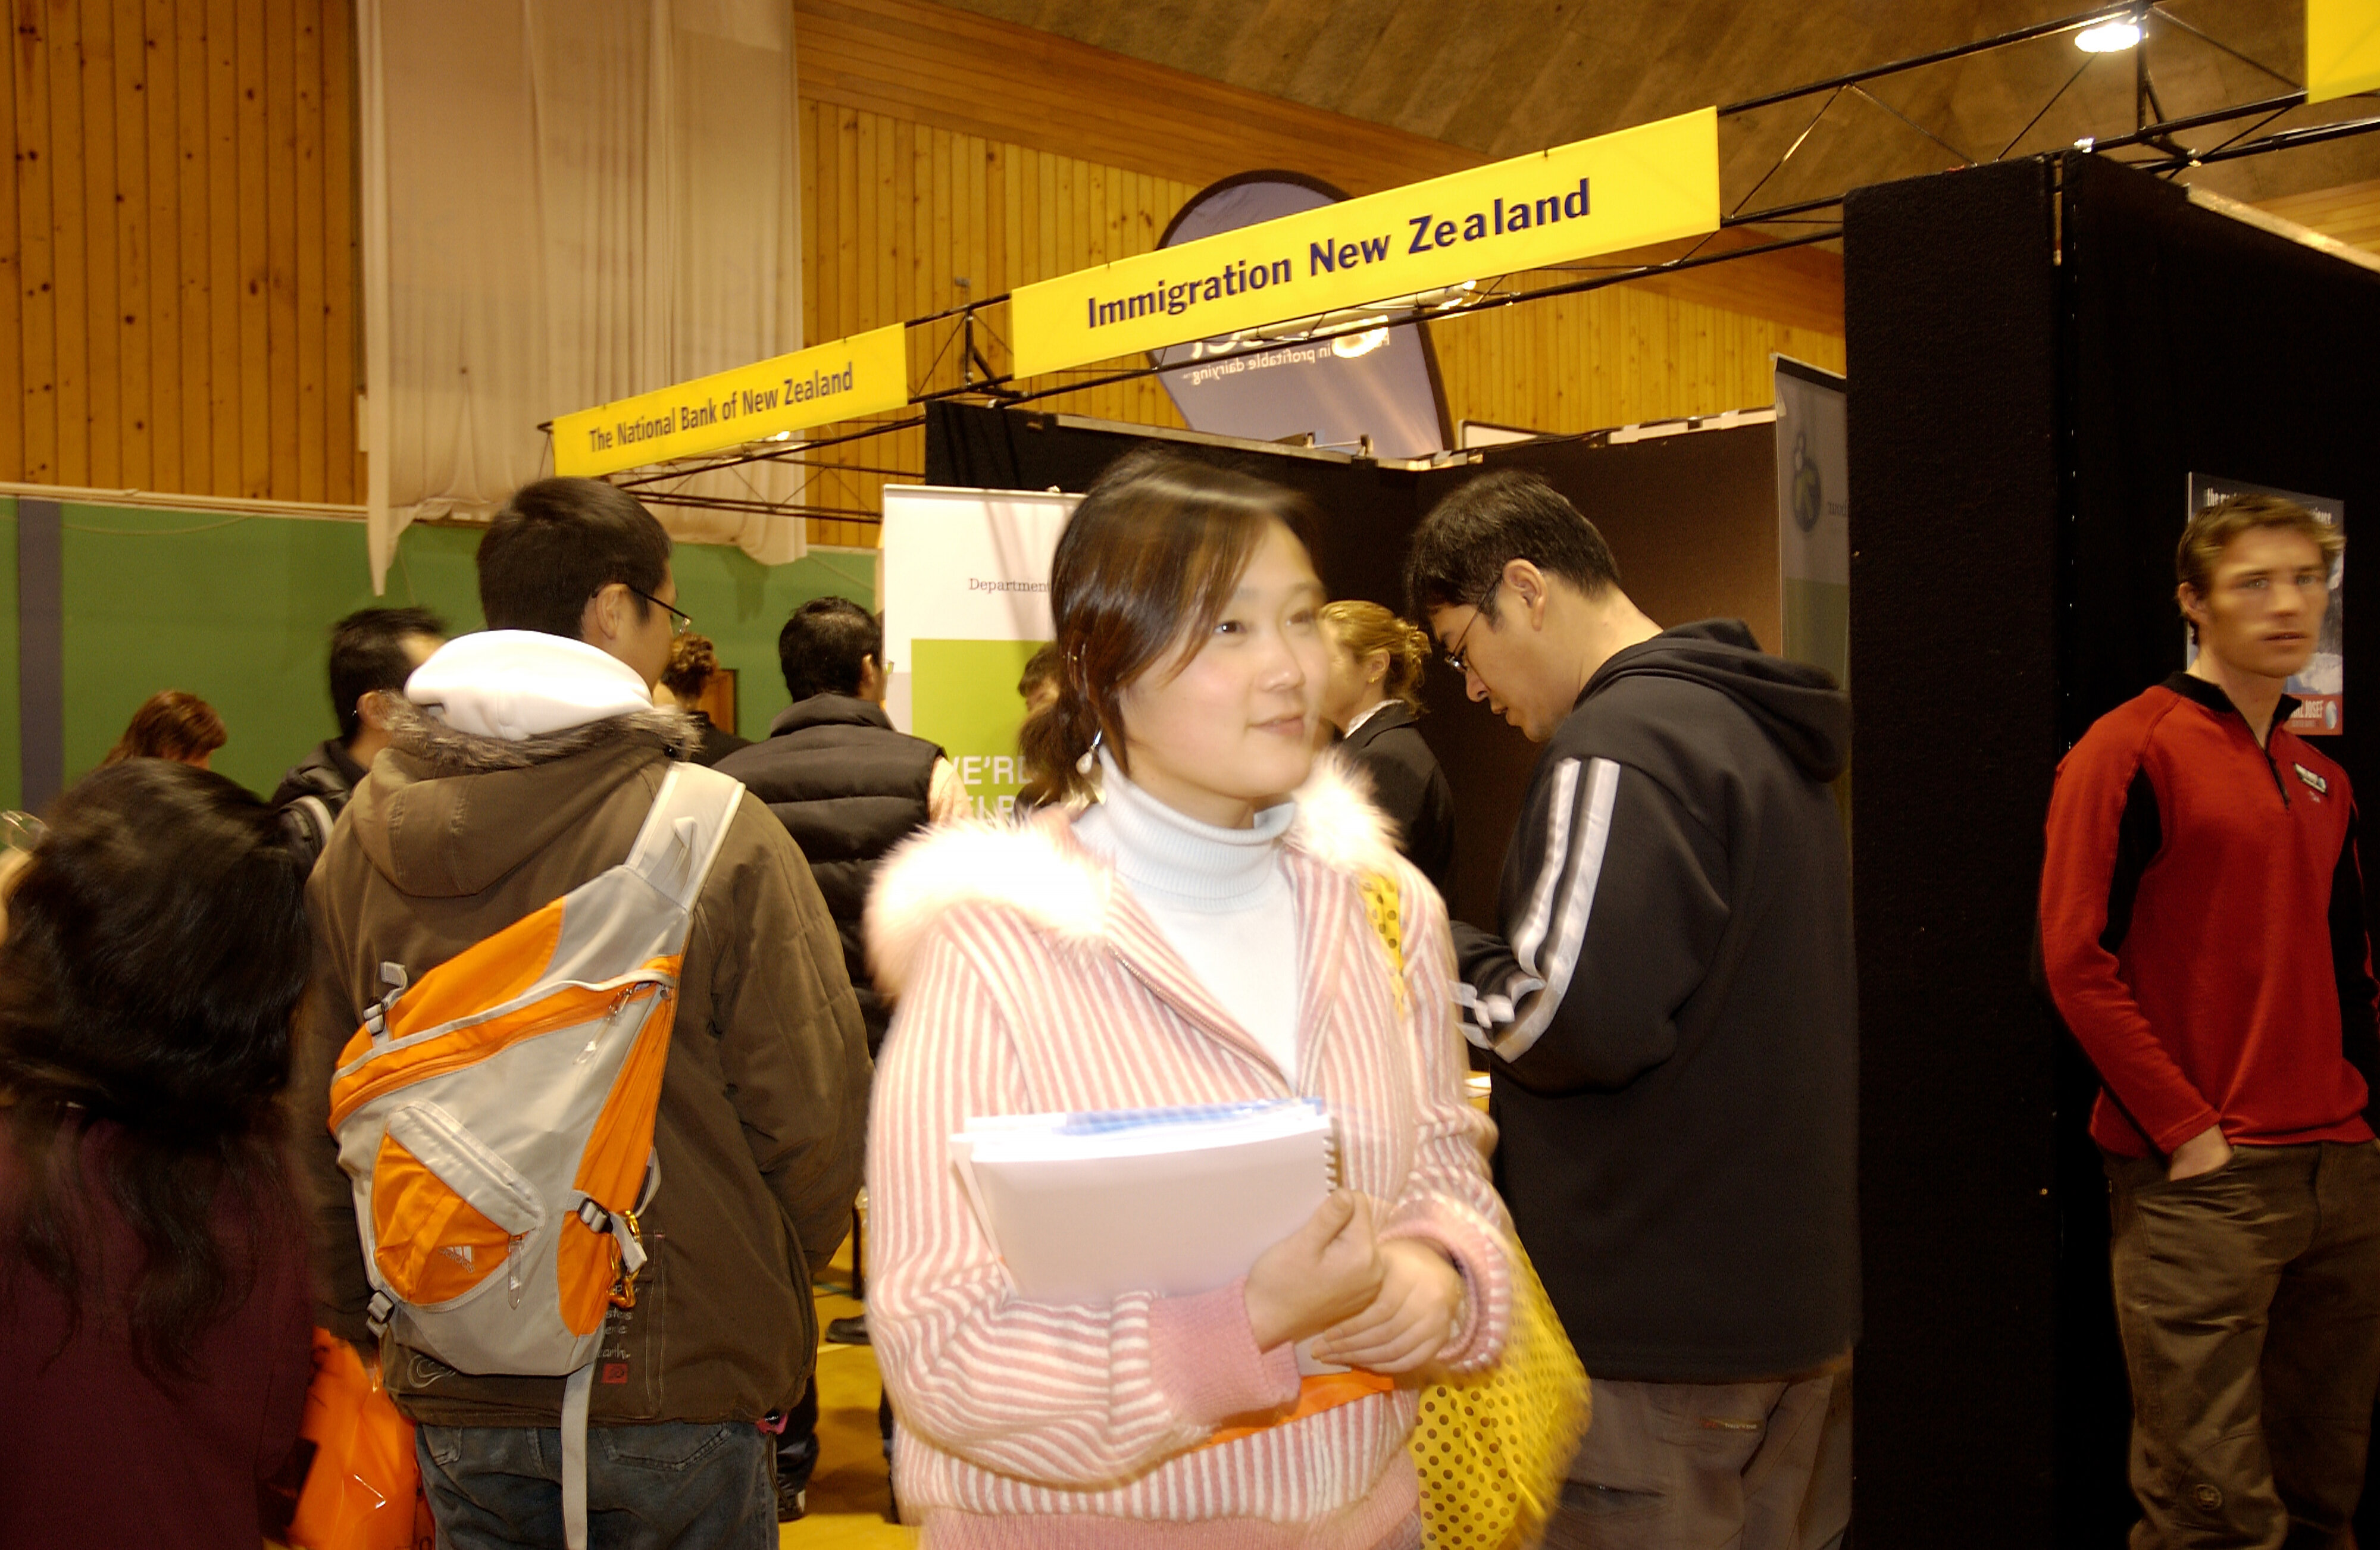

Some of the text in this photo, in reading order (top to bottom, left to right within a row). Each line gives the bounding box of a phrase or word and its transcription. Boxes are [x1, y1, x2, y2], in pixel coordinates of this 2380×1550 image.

[1088, 177, 1591, 329] Immigration New Zealand
[589, 361, 853, 452] The National Bank of New Zealand
[968, 577, 1050, 594] Departmen
